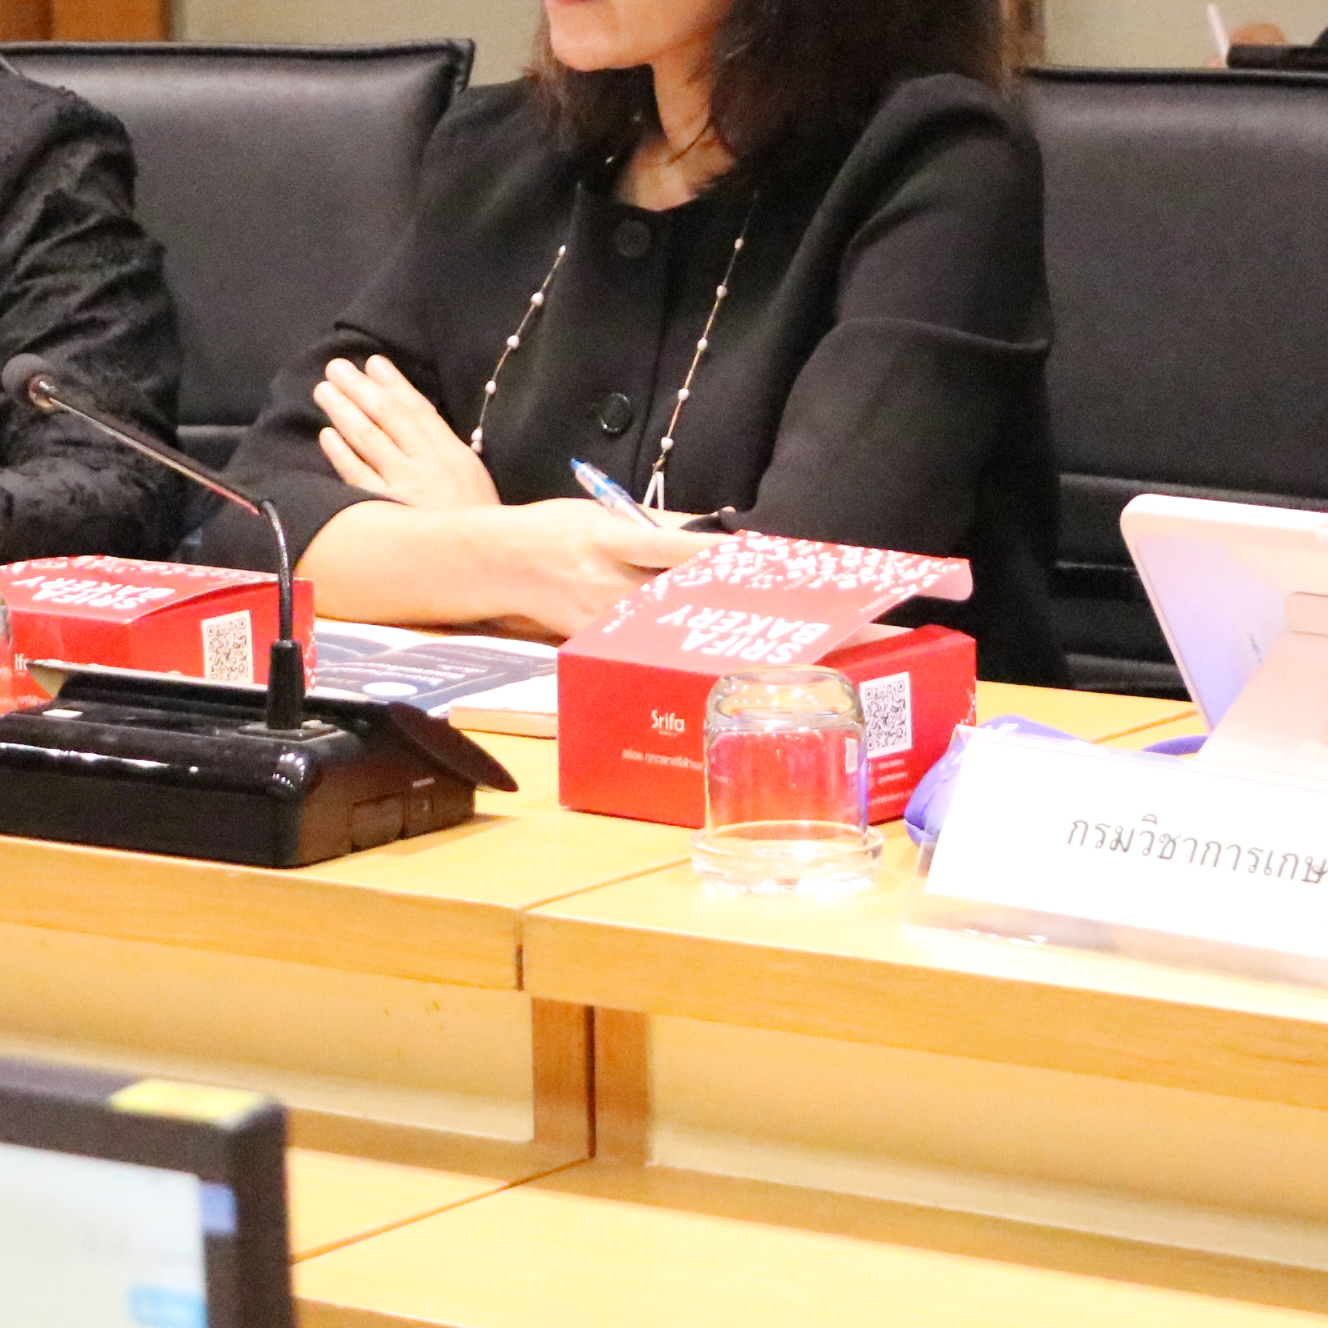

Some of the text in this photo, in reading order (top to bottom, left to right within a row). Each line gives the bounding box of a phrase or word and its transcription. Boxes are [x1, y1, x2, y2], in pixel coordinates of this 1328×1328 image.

[10, 575, 177, 600] BAKERY
[31, 588, 147, 610] SRIFA
[656, 603, 830, 645] BAKERY
[679, 629, 803, 665] SRIFA
